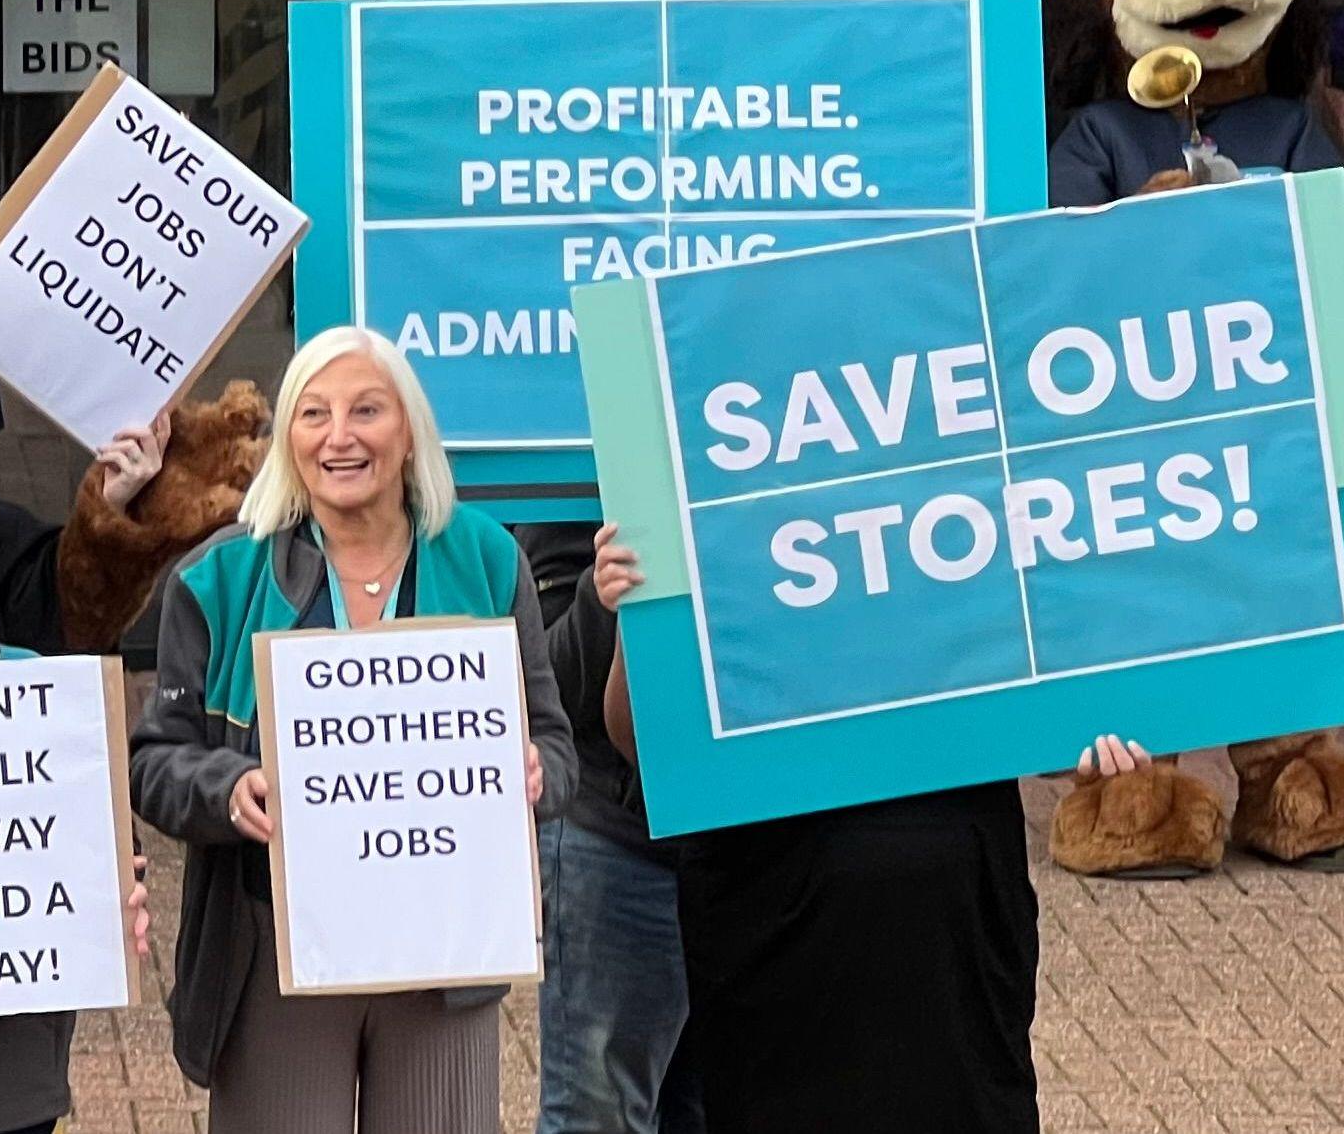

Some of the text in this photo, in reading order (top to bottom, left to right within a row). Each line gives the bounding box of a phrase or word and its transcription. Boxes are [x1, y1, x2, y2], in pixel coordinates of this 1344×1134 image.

[22, 41, 121, 75] BIDS
[478, 84, 859, 134] PROFITABLE.
[115, 104, 280, 249] SAVE OUR
[461, 154, 880, 206] PERFORMING.
[117, 182, 206, 258] JOBS
[9, 234, 184, 385] LIQUIDATE
[703, 300, 1290, 472] SAVE OUR
[770, 444, 1258, 608] STORES!
[304, 651, 488, 692] GORDON
[293, 707, 508, 749] BROTHERS
[303, 763, 505, 806] SAVE OUR
[358, 825, 458, 861] JOBS
[46, 880, 76, 916] A
